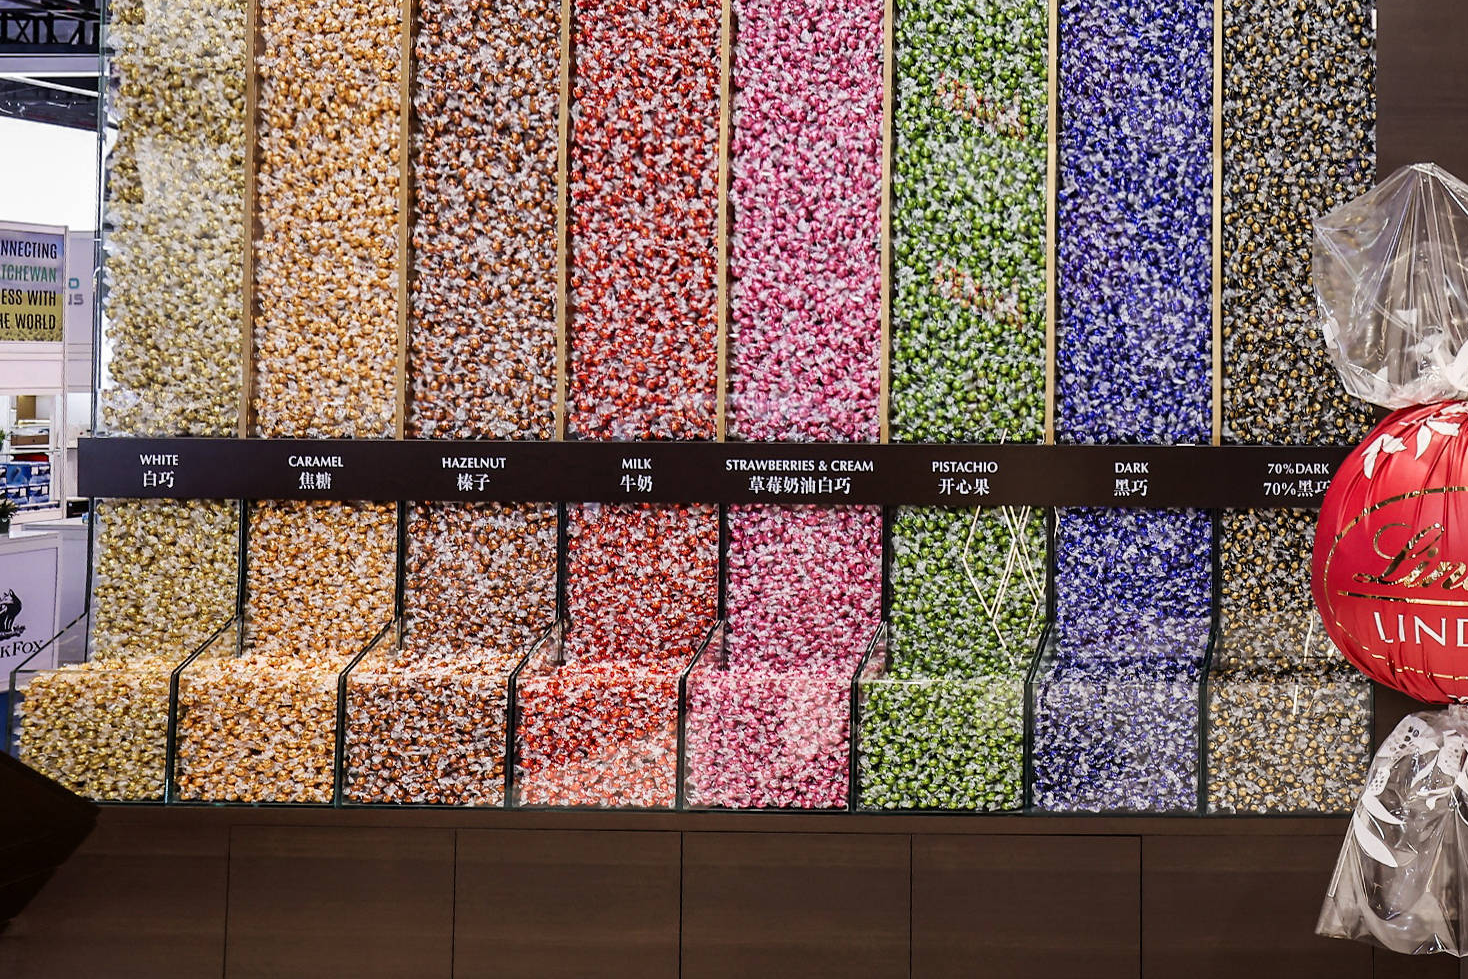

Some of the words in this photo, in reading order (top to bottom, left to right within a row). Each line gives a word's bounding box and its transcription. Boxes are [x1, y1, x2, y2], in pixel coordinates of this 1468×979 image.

[0, 264, 57, 283] TCHEWAN
[27, 289, 56, 307] WITH
[15, 313, 56, 330] WORLD
[139, 454, 179, 466] WHITE
[288, 455, 344, 467] CARAMEL
[441, 457, 507, 469] HAZELNUT
[621, 458, 652, 469] MILK
[725, 459, 815, 471] STRAWBERRIES
[818, 460, 828, 472] &
[831, 460, 874, 472] CREAM
[932, 461, 998, 473] PISTACHIO
[1114, 462, 1149, 474] DARK
[142, 470, 175, 488] 白巧
[298, 471, 332, 490] 焦糖
[456, 473, 491, 492] 榛子
[619, 474, 653, 493] 牛奶
[748, 476, 851, 495] 草莓奶油白巧
[938, 477, 990, 496] 开心果
[1113, 479, 1148, 497] 黑巧
